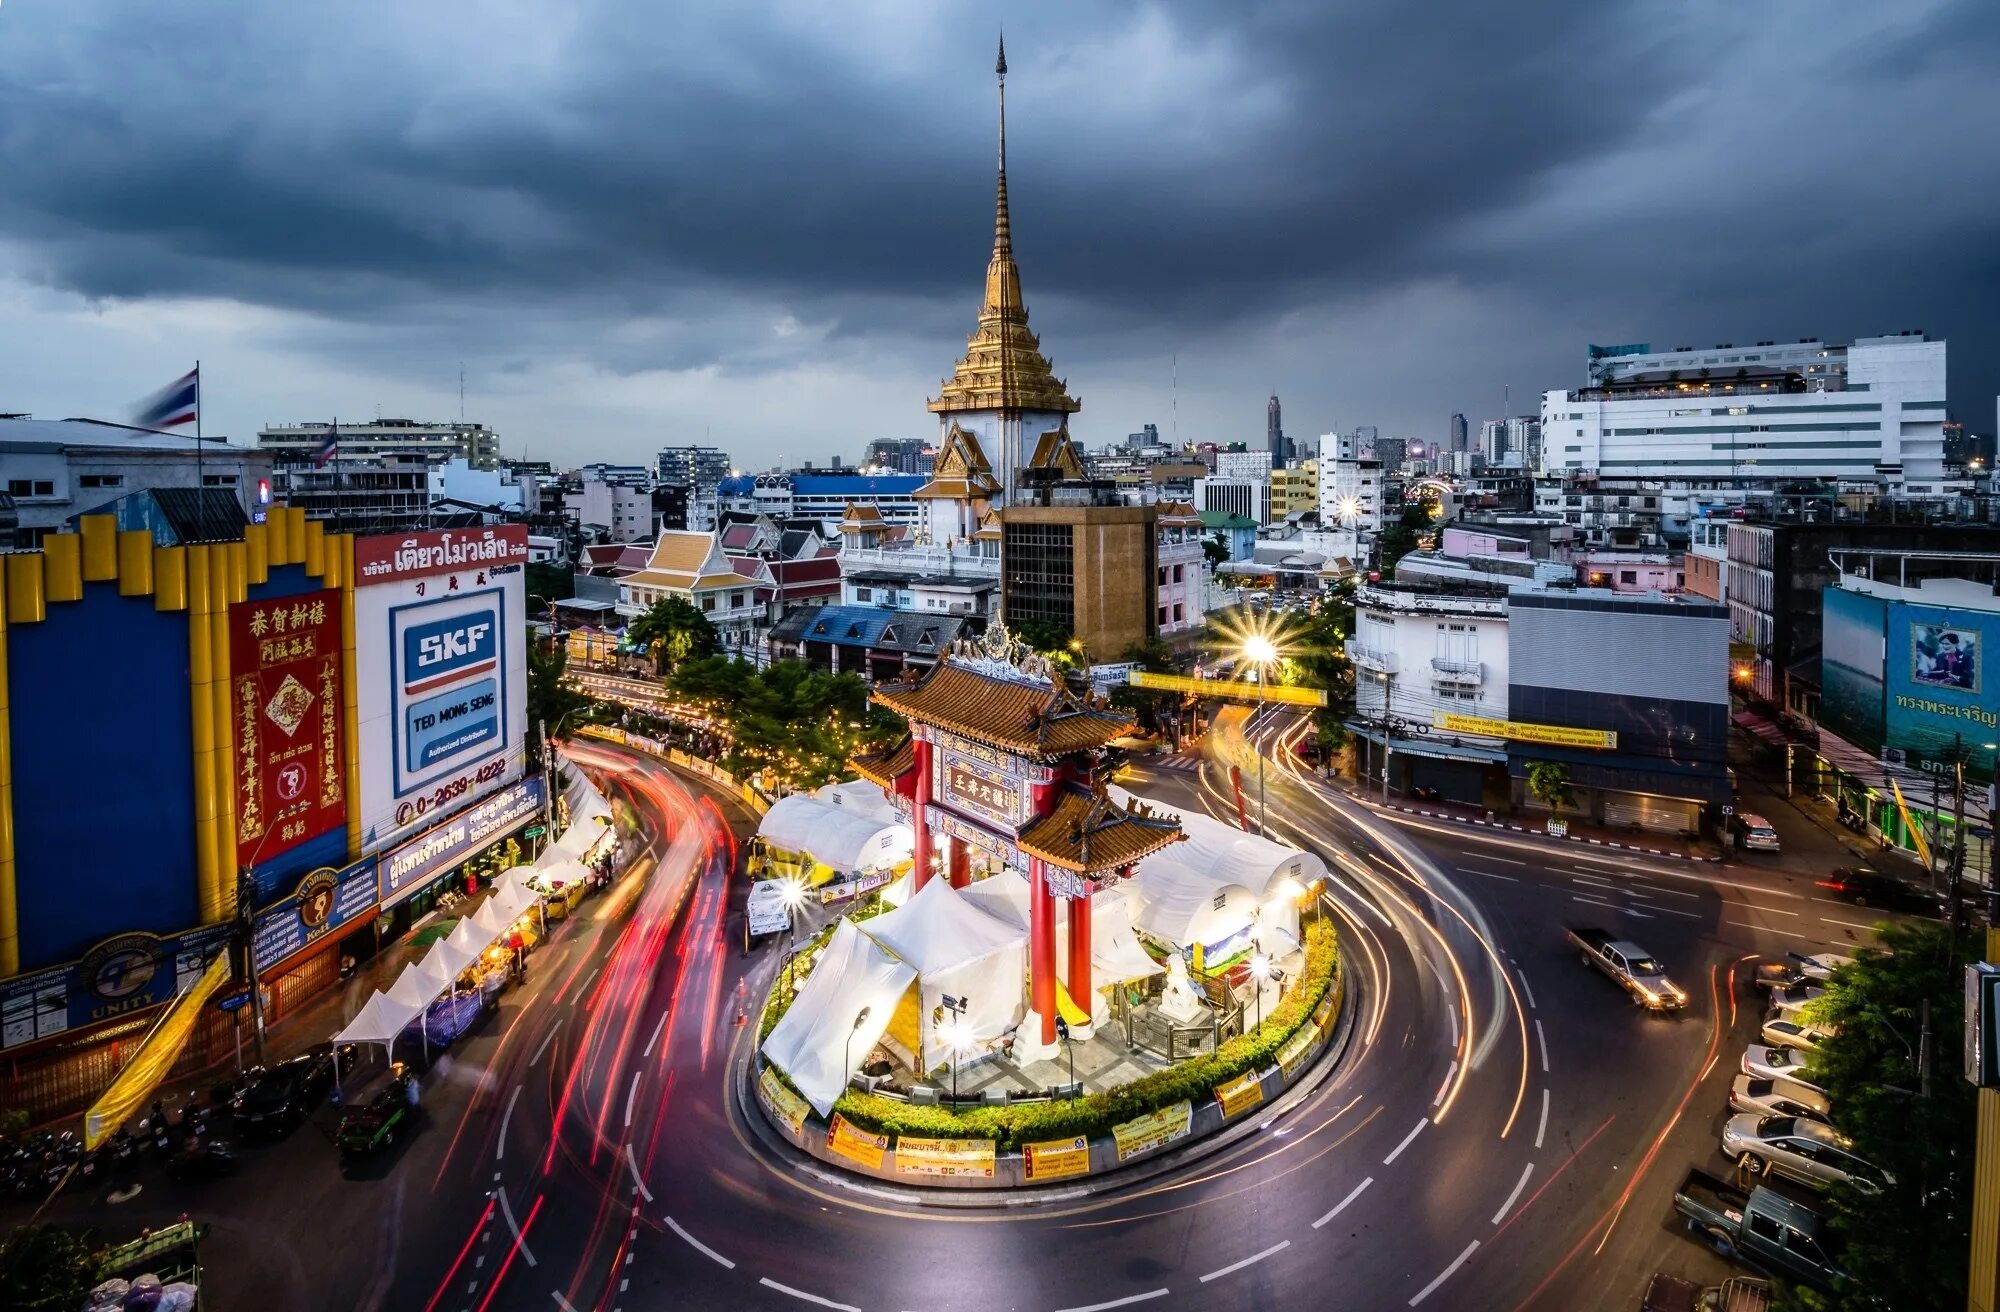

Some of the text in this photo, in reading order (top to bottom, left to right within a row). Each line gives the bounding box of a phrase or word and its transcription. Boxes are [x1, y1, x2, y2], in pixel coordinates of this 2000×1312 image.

[363, 561, 392, 576] บริษัท
[394, 530, 508, 572] เตียวโม่วเส็ง
[418, 622, 489, 667] SKF
[413, 692, 495, 733] TEO MONG SENG
[1896, 695, 1996, 728] ทรงพระเจริญ
[428, 727, 488, 758] Authorized Distributor
[417, 758, 506, 815] 0-2639-4222
[90, 992, 156, 1019] UNITY
